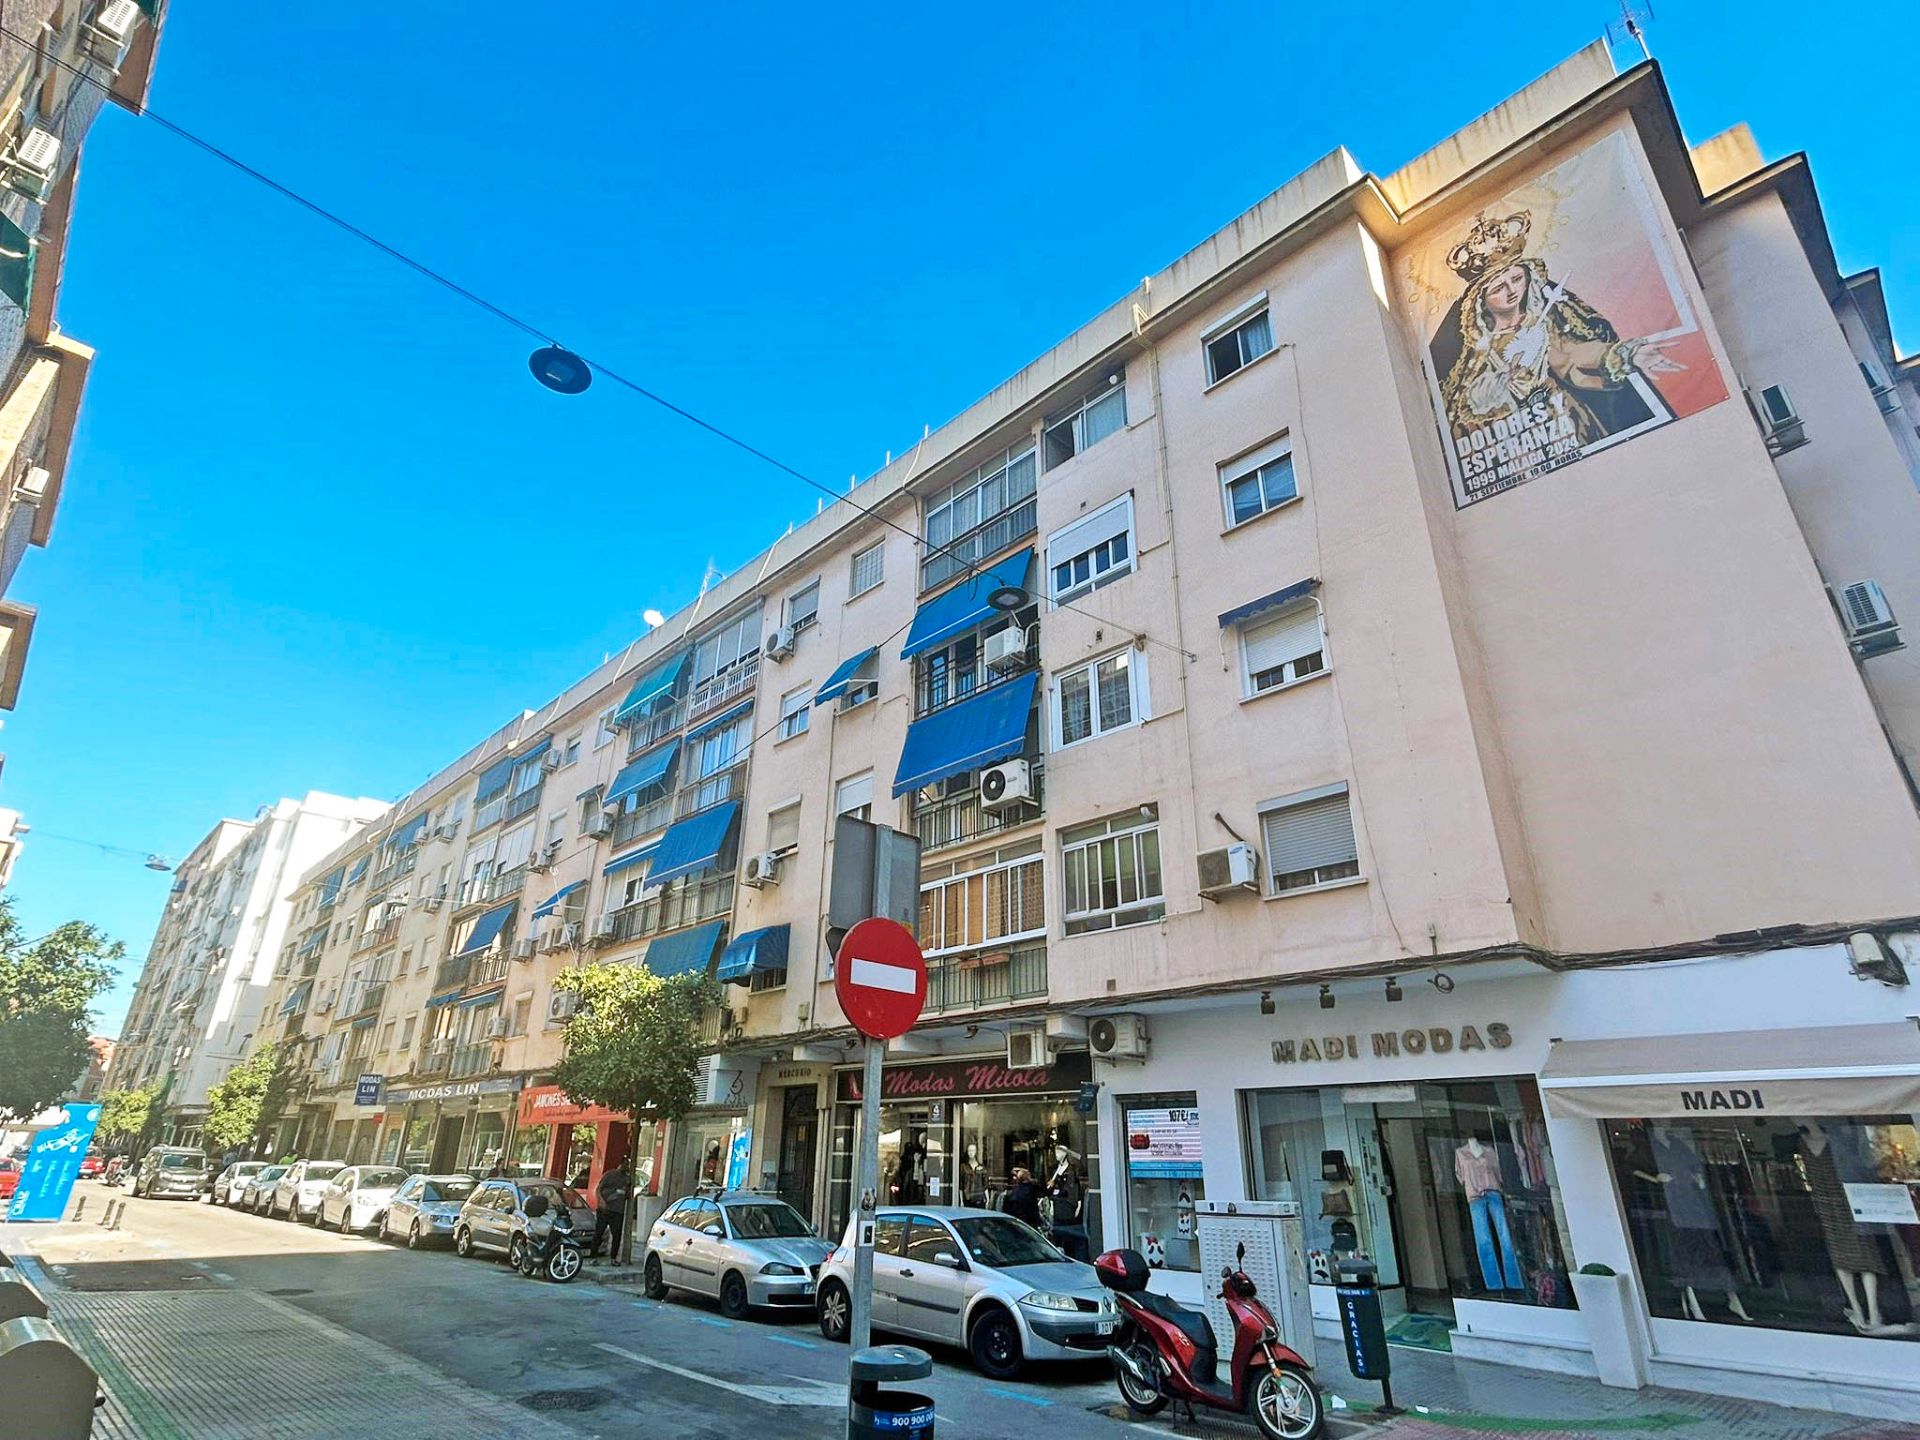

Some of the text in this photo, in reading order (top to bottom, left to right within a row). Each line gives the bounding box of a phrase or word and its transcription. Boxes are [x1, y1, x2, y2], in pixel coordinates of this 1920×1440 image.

[1457, 392, 1565, 458] DOLORES Y
[1461, 415, 1577, 479] ESPERANZA
[1467, 469, 1496, 491] 1999
[1546, 434, 1580, 460] 2024
[1481, 472, 1527, 497] SEPTIEMBRE
[1554, 450, 1583, 467] HORAS
[1271, 1022, 1513, 1064] MADI MODAS
[360, 1075, 381, 1084] MODAS
[361, 1085, 376, 1093] LIN
[456, 1082, 480, 1096] LIN
[885, 1070, 956, 1094] Modas
[1681, 1089, 1765, 1111] MADI
[1347, 1301, 1365, 1368] GRACIAS
[892, 1417, 910, 1427] 900
[910, 1415, 925, 1425] 900
